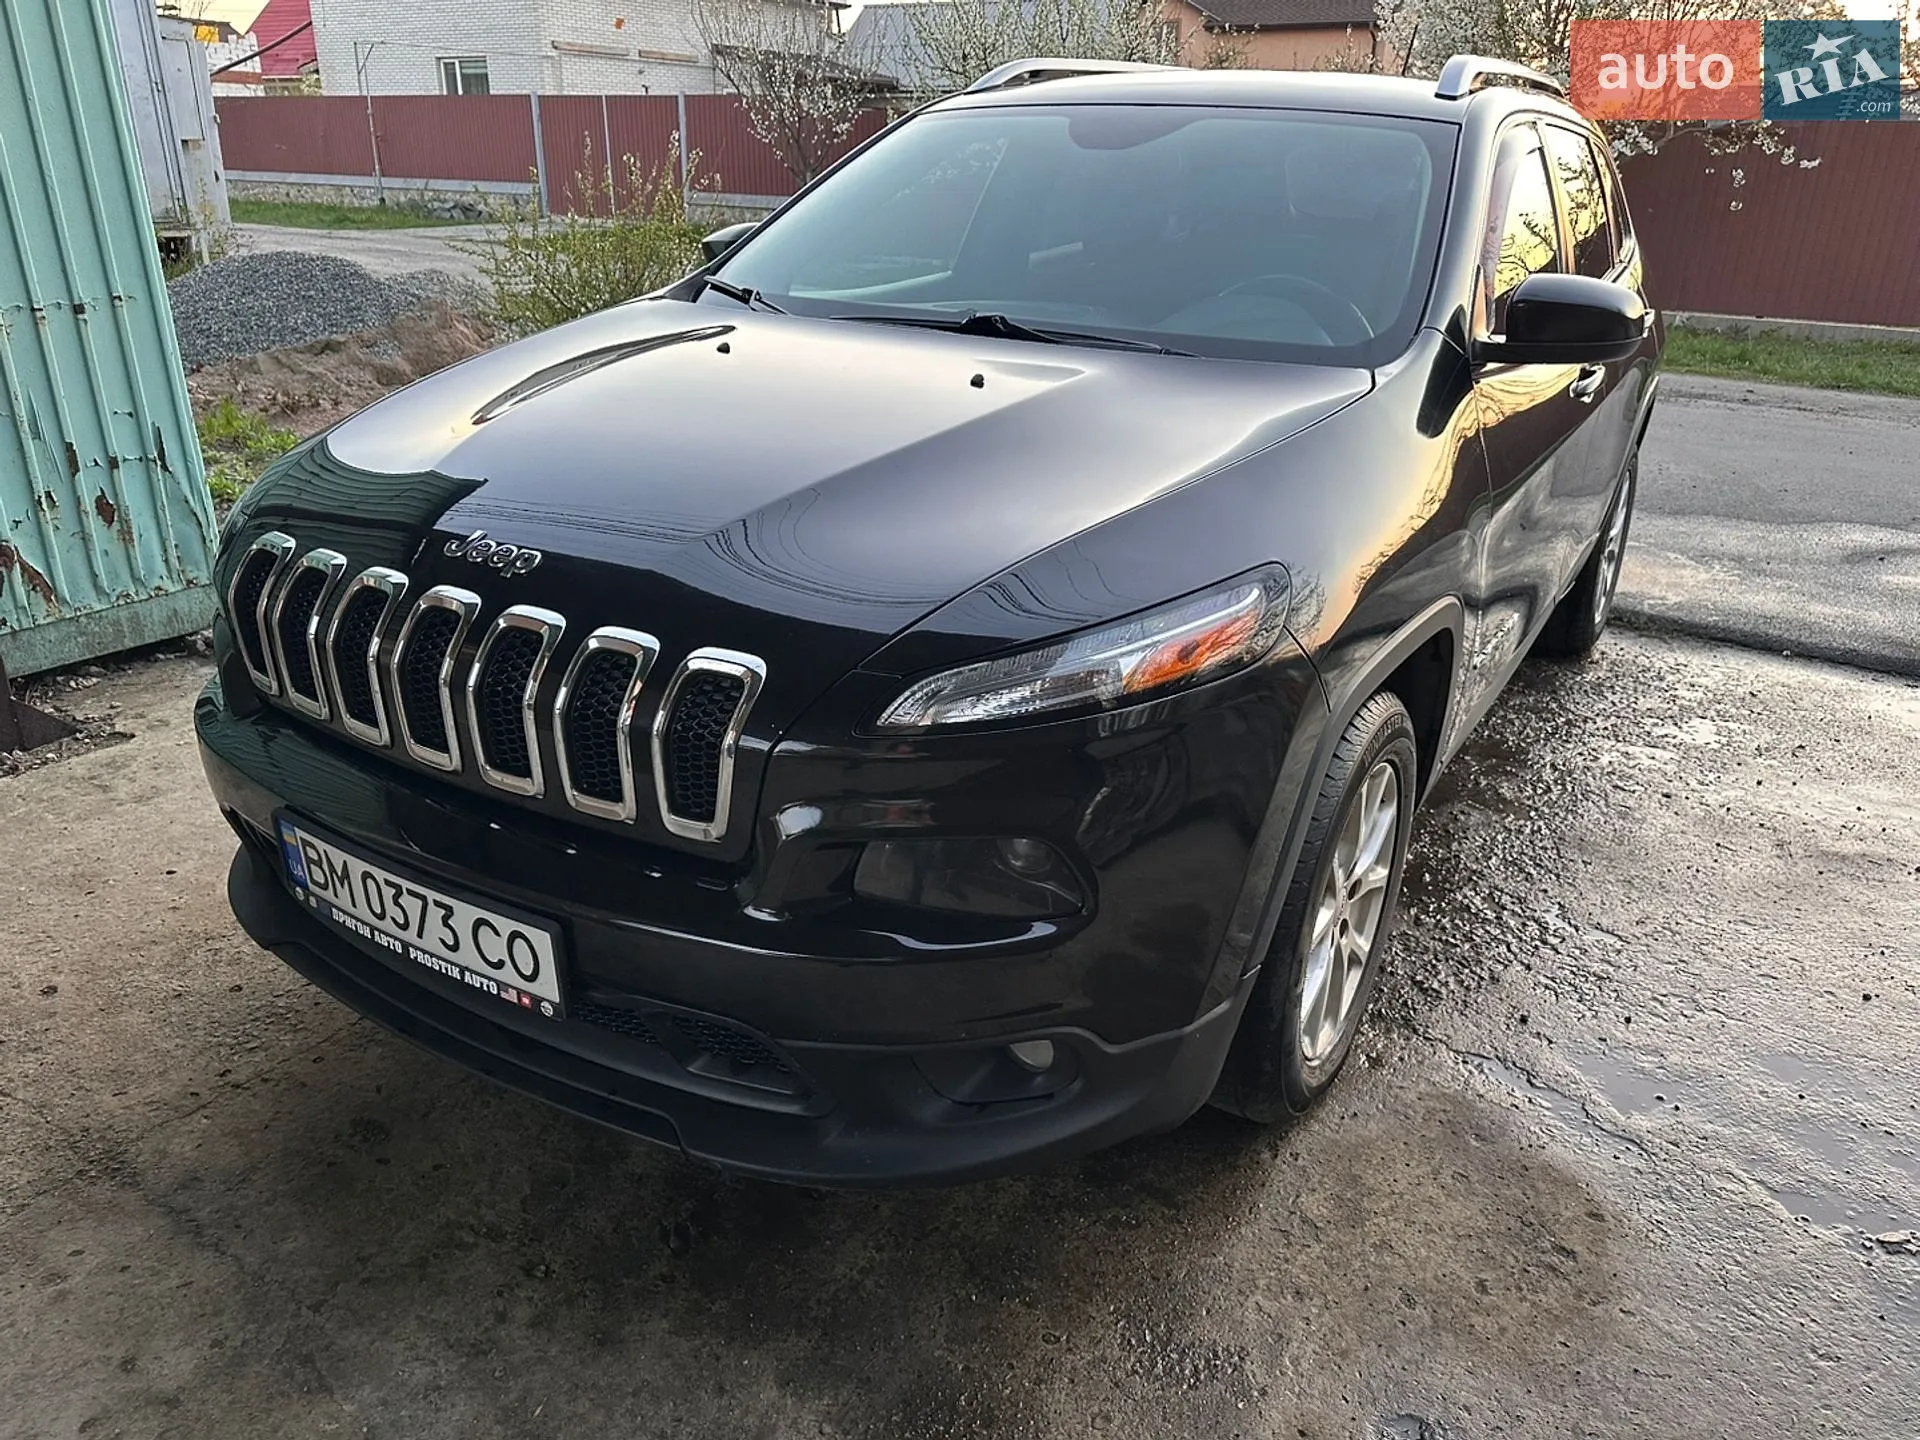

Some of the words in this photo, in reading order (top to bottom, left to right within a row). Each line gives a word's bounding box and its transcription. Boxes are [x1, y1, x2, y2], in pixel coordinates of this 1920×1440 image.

[444, 530, 542, 578] Jeep
[289, 858, 306, 880] UA
[299, 835, 357, 909] BM
[361, 869, 460, 953] 0373
[471, 917, 540, 983] CO
[331, 907, 372, 939] ПРИГОН
[374, 930, 403, 954] АВТО
[408, 947, 462, 980] PROSTIK
[464, 970, 499, 995] AUTO
